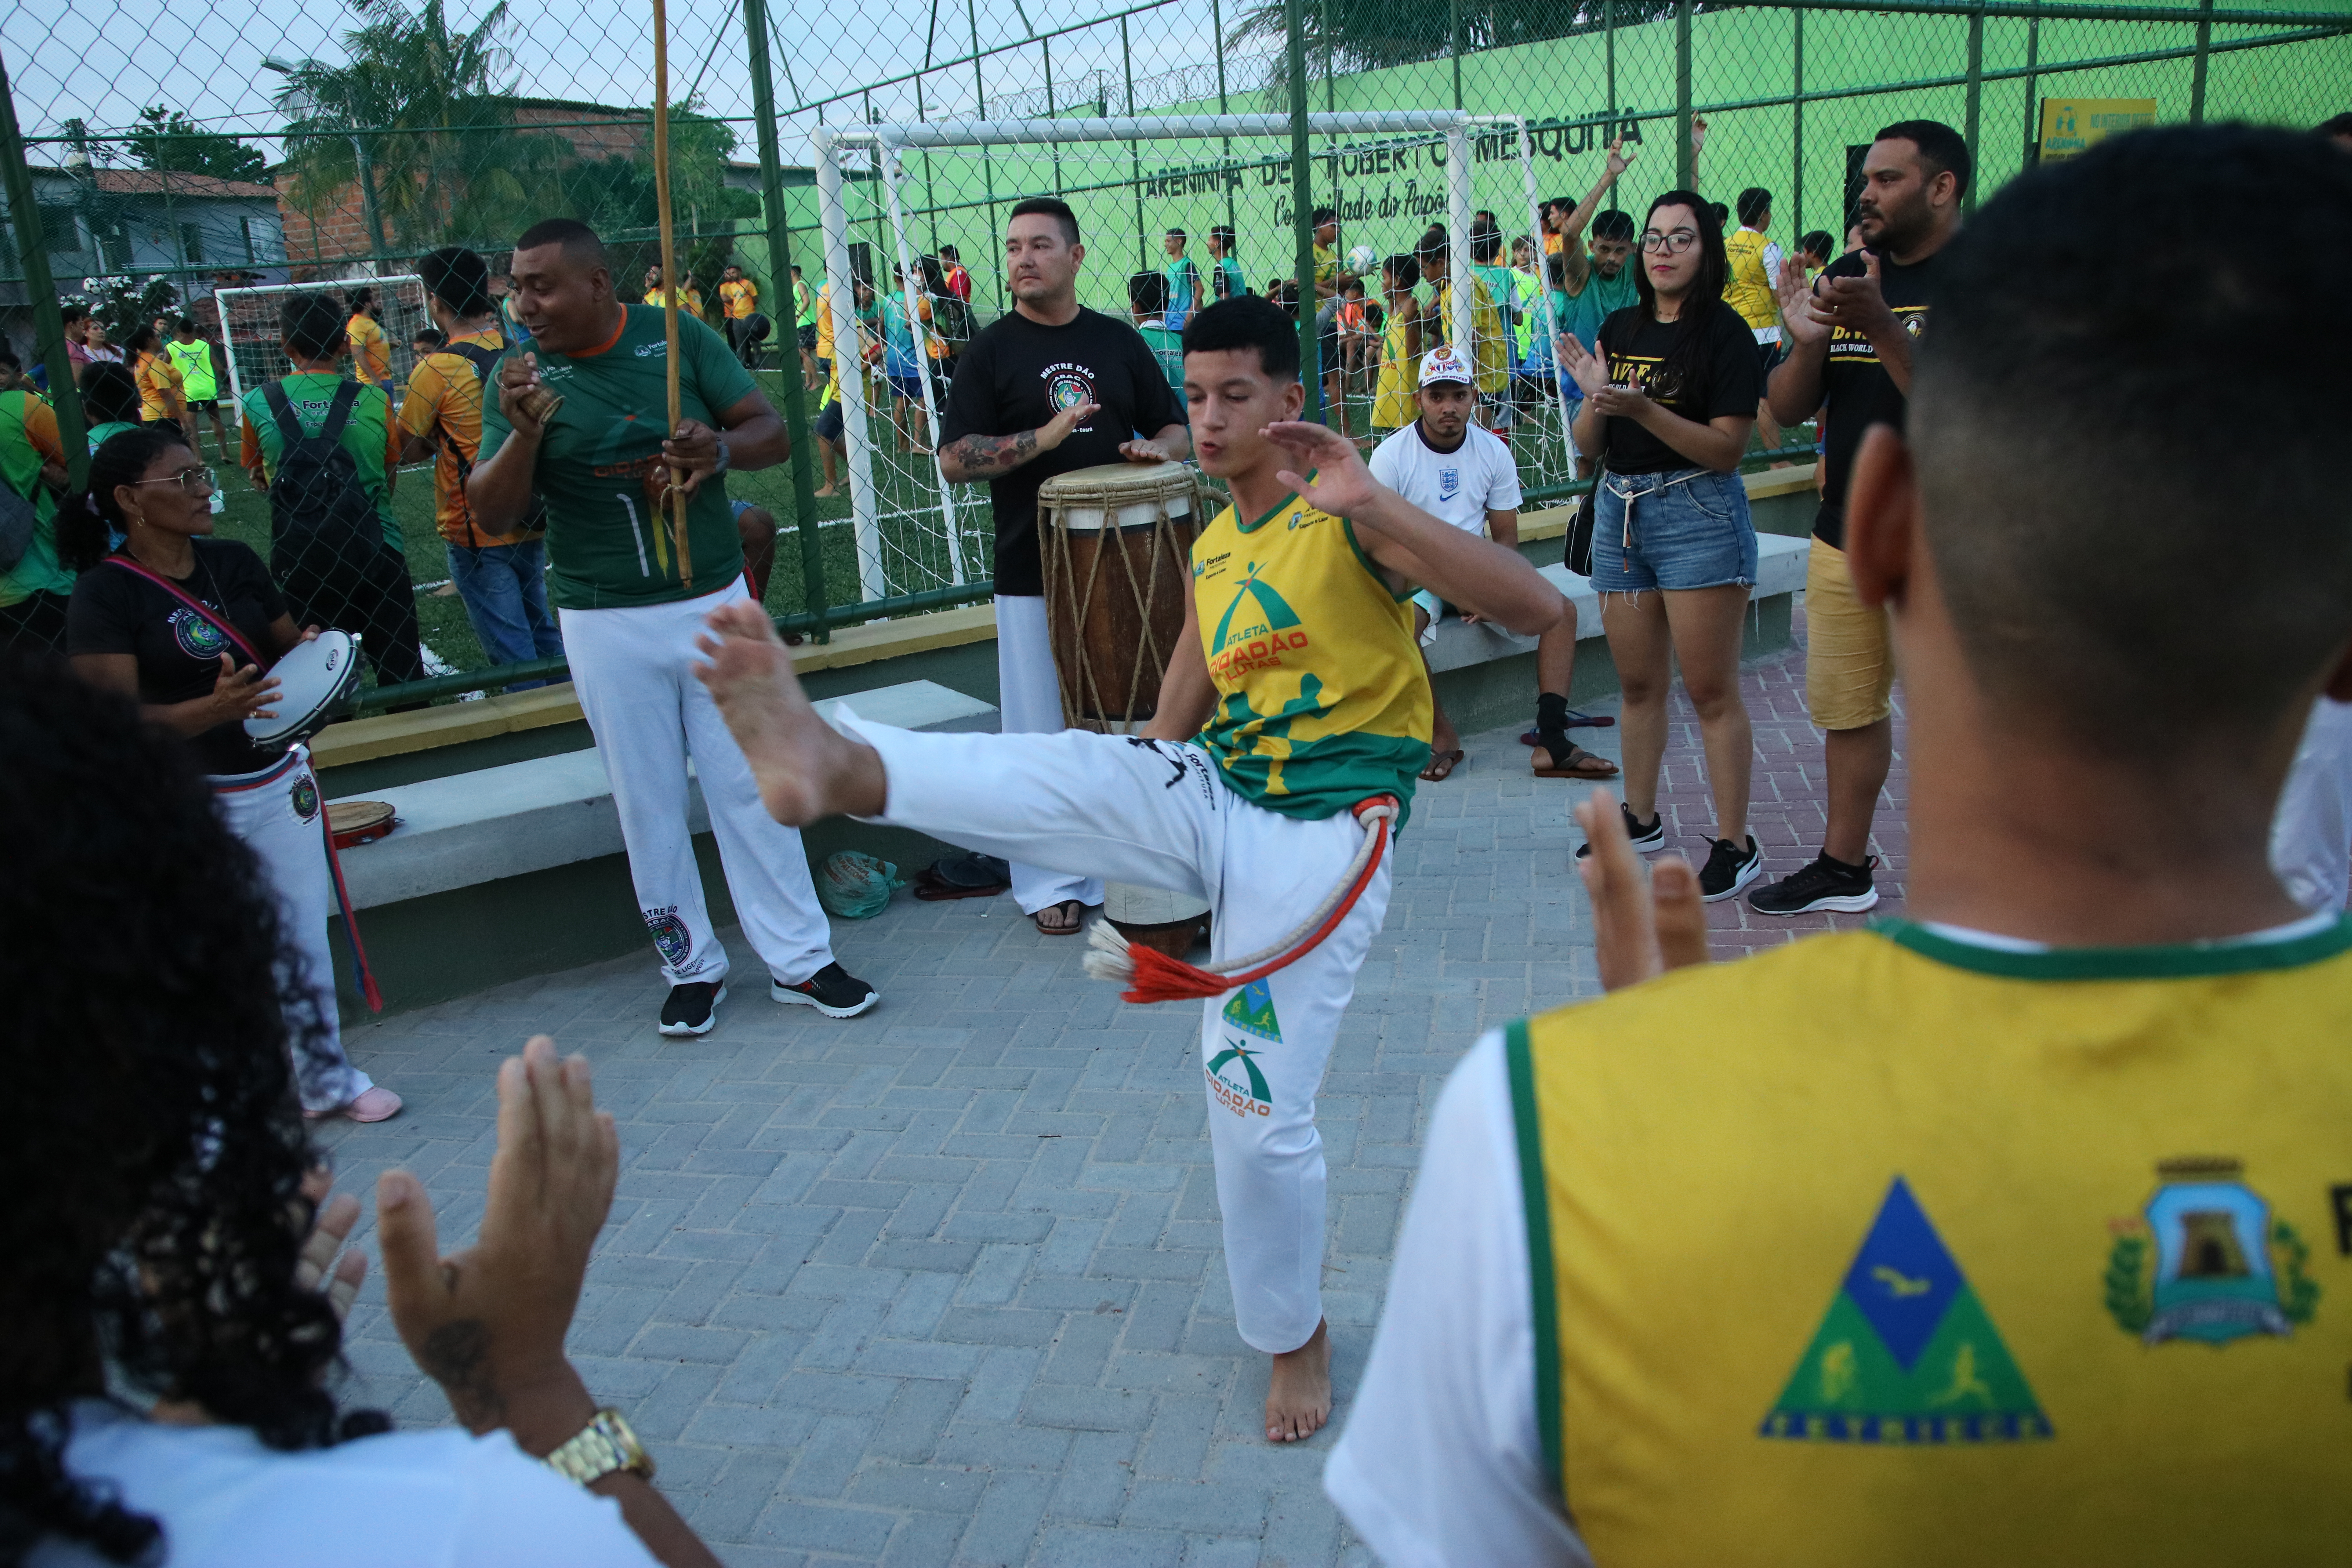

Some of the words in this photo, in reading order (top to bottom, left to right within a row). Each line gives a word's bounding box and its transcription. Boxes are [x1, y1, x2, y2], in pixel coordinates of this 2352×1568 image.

[1145, 159, 1243, 199] ARENINHA
[1475, 106, 1642, 163] MESQUITA
[1378, 181, 1400, 218] do
[1405, 178, 1450, 225] Papô
[648, 340, 667, 349] Fortale
[1830, 344, 1847, 353] BLACK
[1848, 343, 1874, 353] WORLD
[1040, 363, 1073, 379] MESTRE
[1076, 365, 1095, 379] DÃO
[1206, 552, 1230, 566] Fortaleza
[1227, 623, 1269, 647] ATLETA
[1209, 631, 1308, 677] CIDADÃO
[1225, 656, 1282, 681] LUTAS
[642, 908, 666, 920] STRE
[647, 916, 670, 927] ABAC
[1205, 1069, 1270, 1116] CIDADÃO
[1218, 1074, 1250, 1097] ATLETA
[1216, 1093, 1245, 1118] LUTAS
